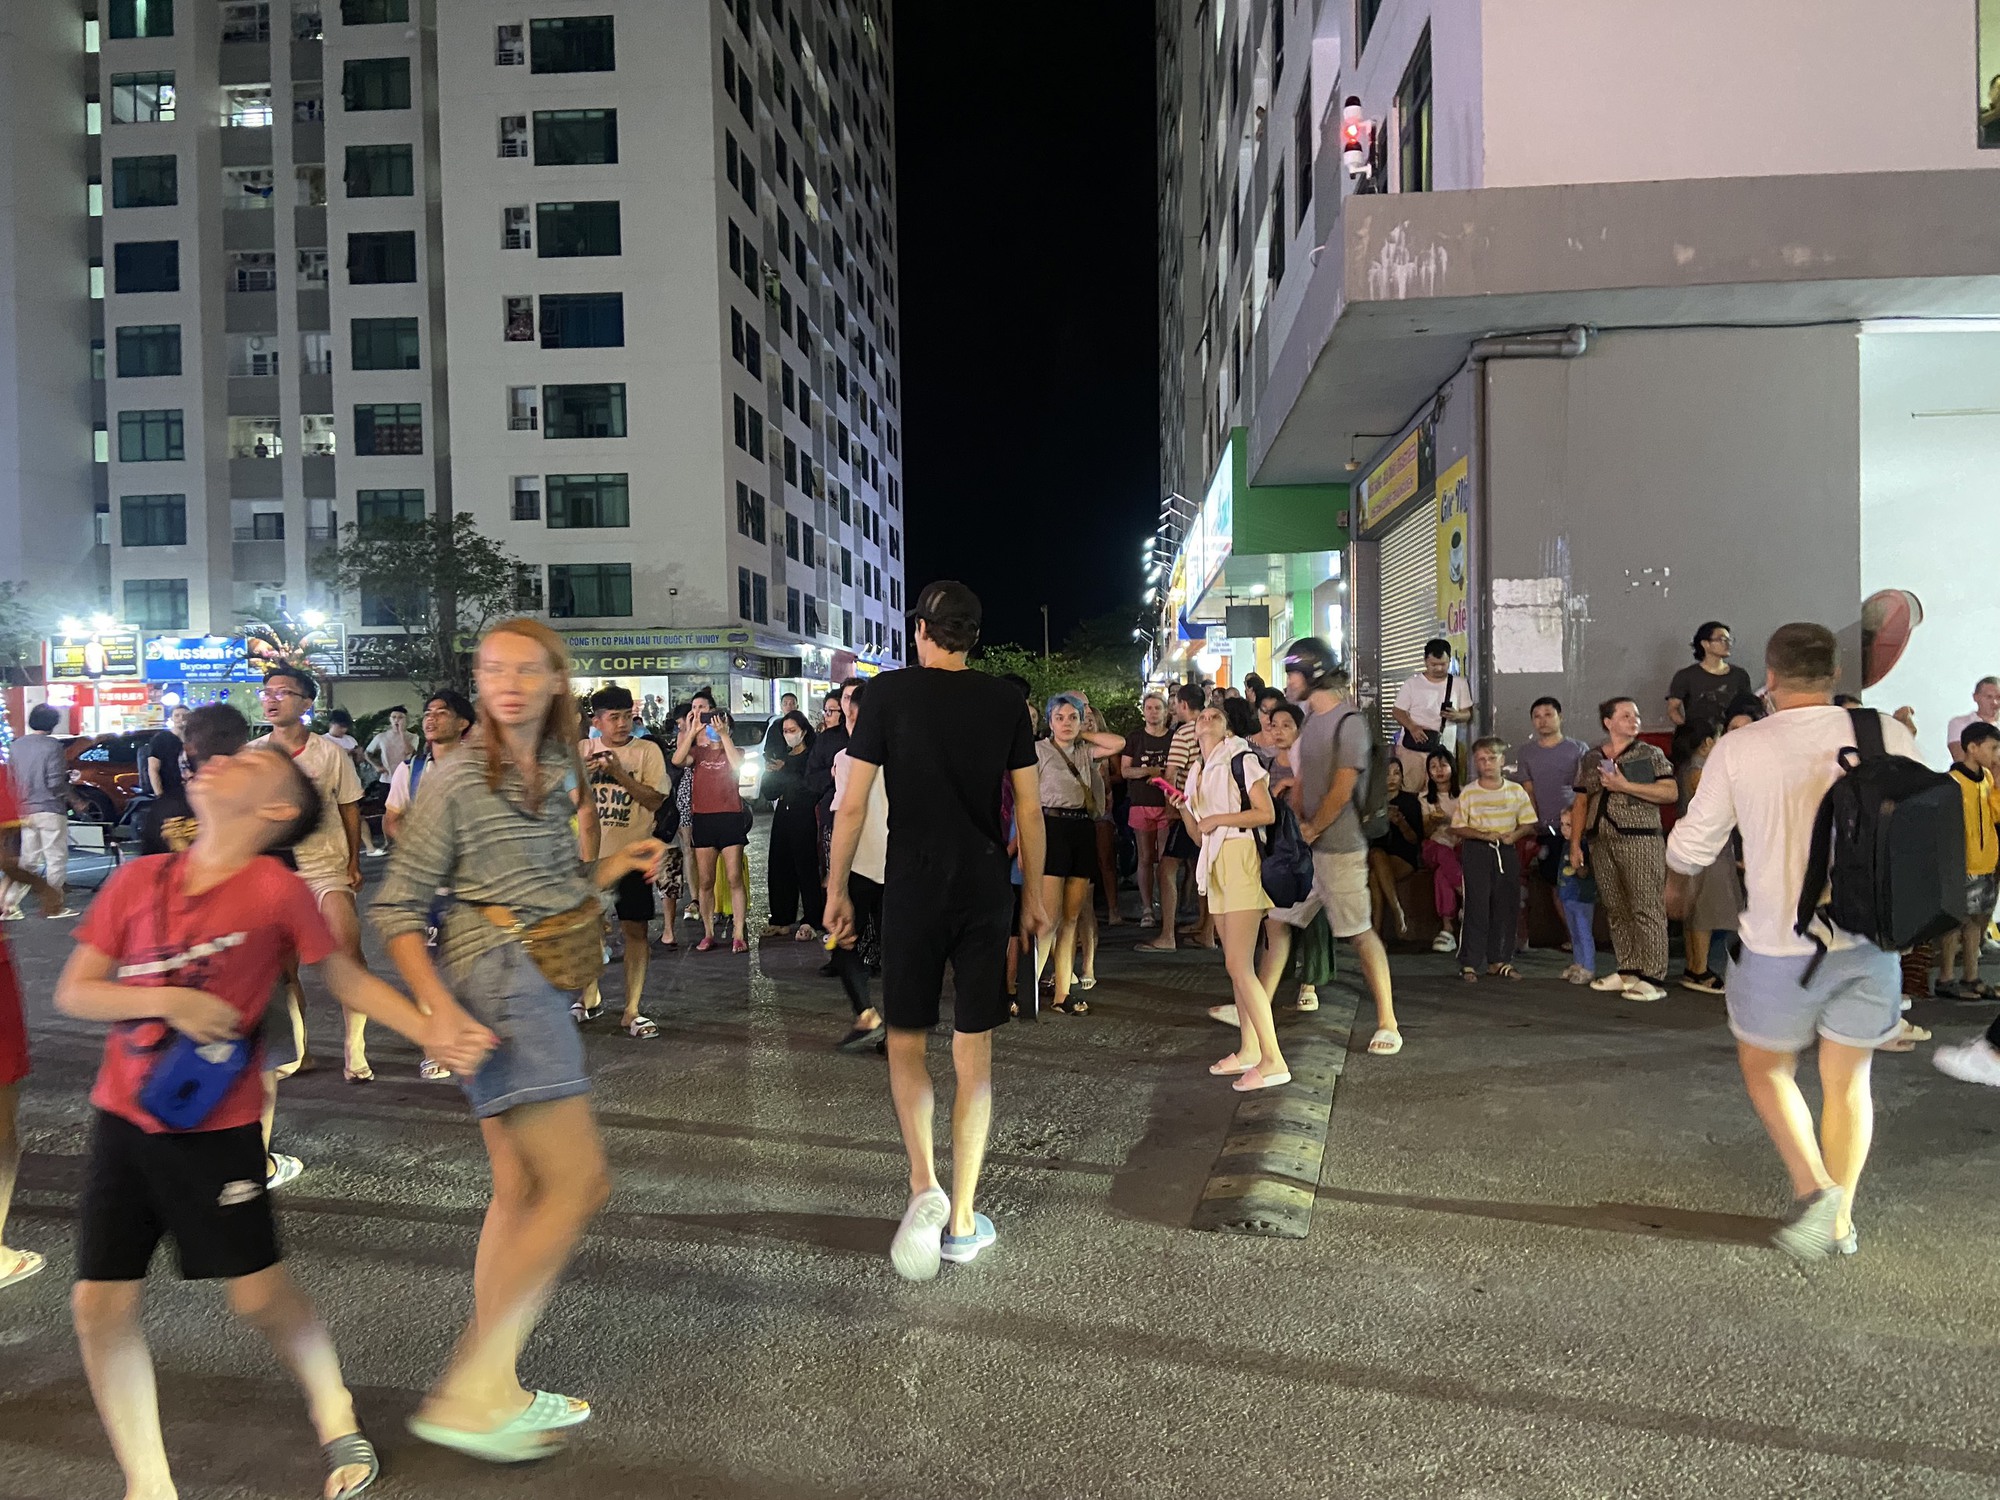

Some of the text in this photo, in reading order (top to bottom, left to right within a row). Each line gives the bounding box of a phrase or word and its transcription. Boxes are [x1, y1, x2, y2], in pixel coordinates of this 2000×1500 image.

[600, 656, 682, 671] COFFEE
[611, 788, 634, 806] NO
[598, 806, 631, 822] DLINE
